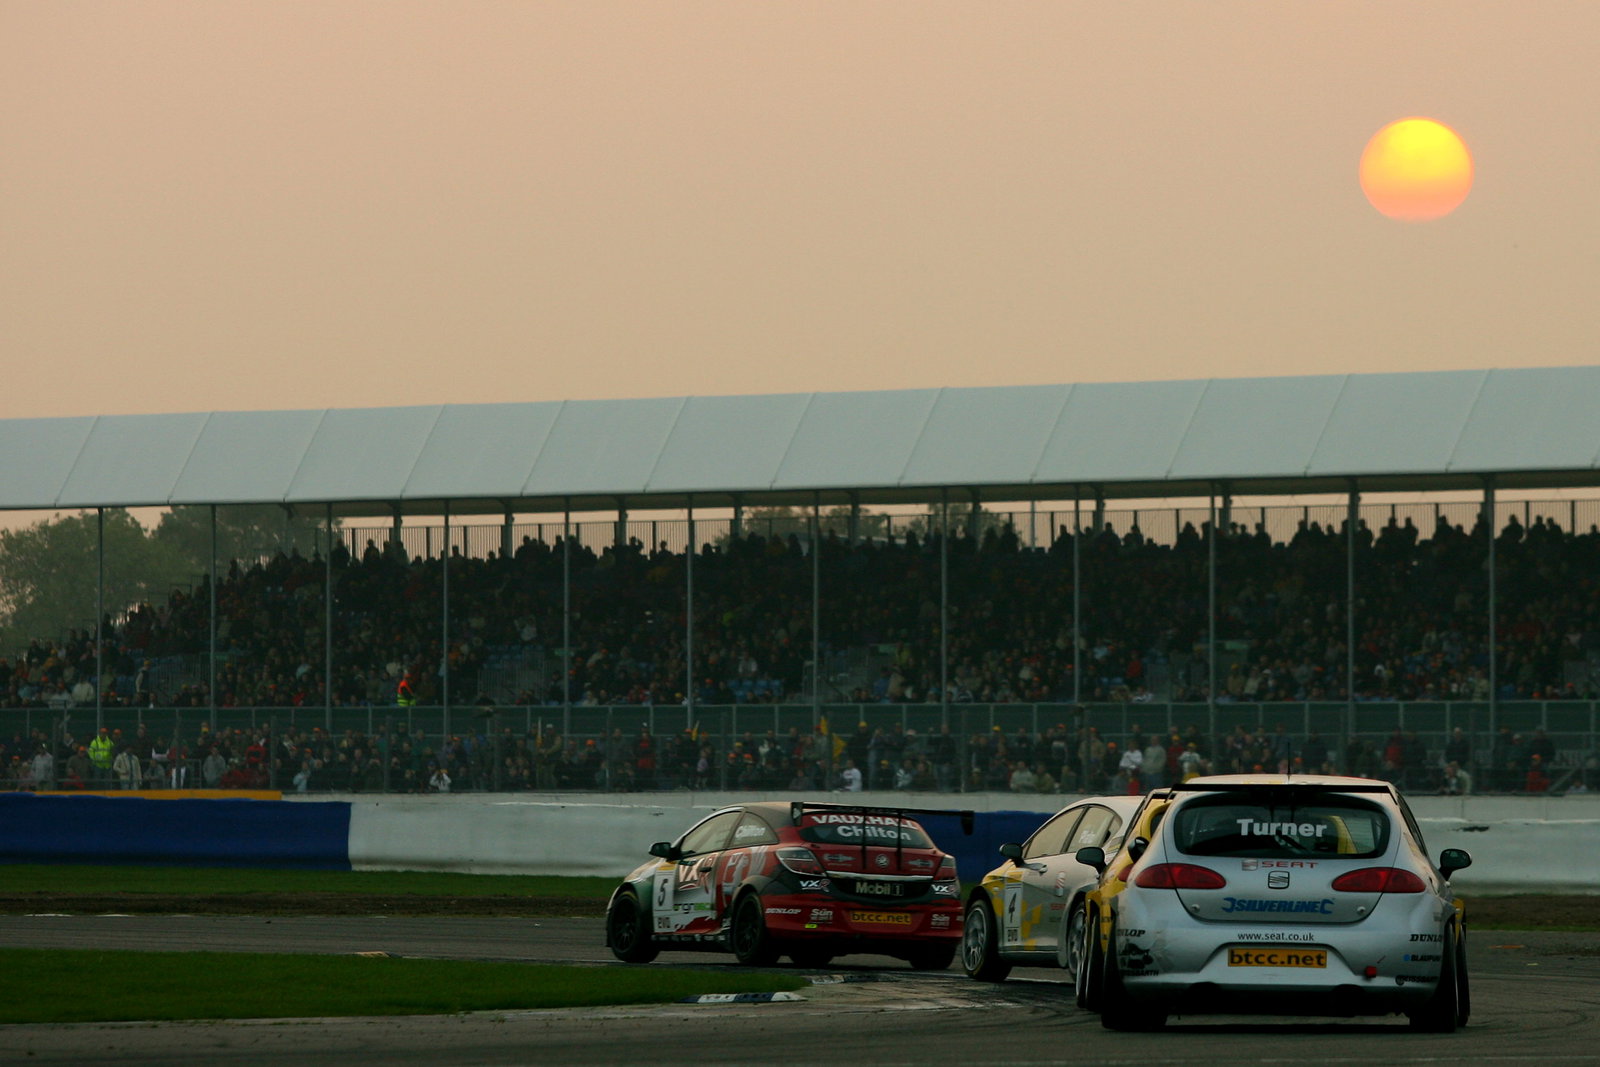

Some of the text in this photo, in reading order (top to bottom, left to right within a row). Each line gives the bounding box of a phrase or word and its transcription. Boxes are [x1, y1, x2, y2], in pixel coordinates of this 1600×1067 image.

[836, 825, 912, 841] Chilton
[1236, 818, 1328, 838] Turner
[1262, 861, 1319, 869] SEAT
[657, 879, 668, 907] 5
[855, 881, 890, 896] Mobil
[1008, 892, 1017, 924] 4
[851, 911, 911, 925] btcc.net
[1238, 932, 1314, 942] www.seat.co.uk
[1230, 951, 1327, 967] btcc.net
